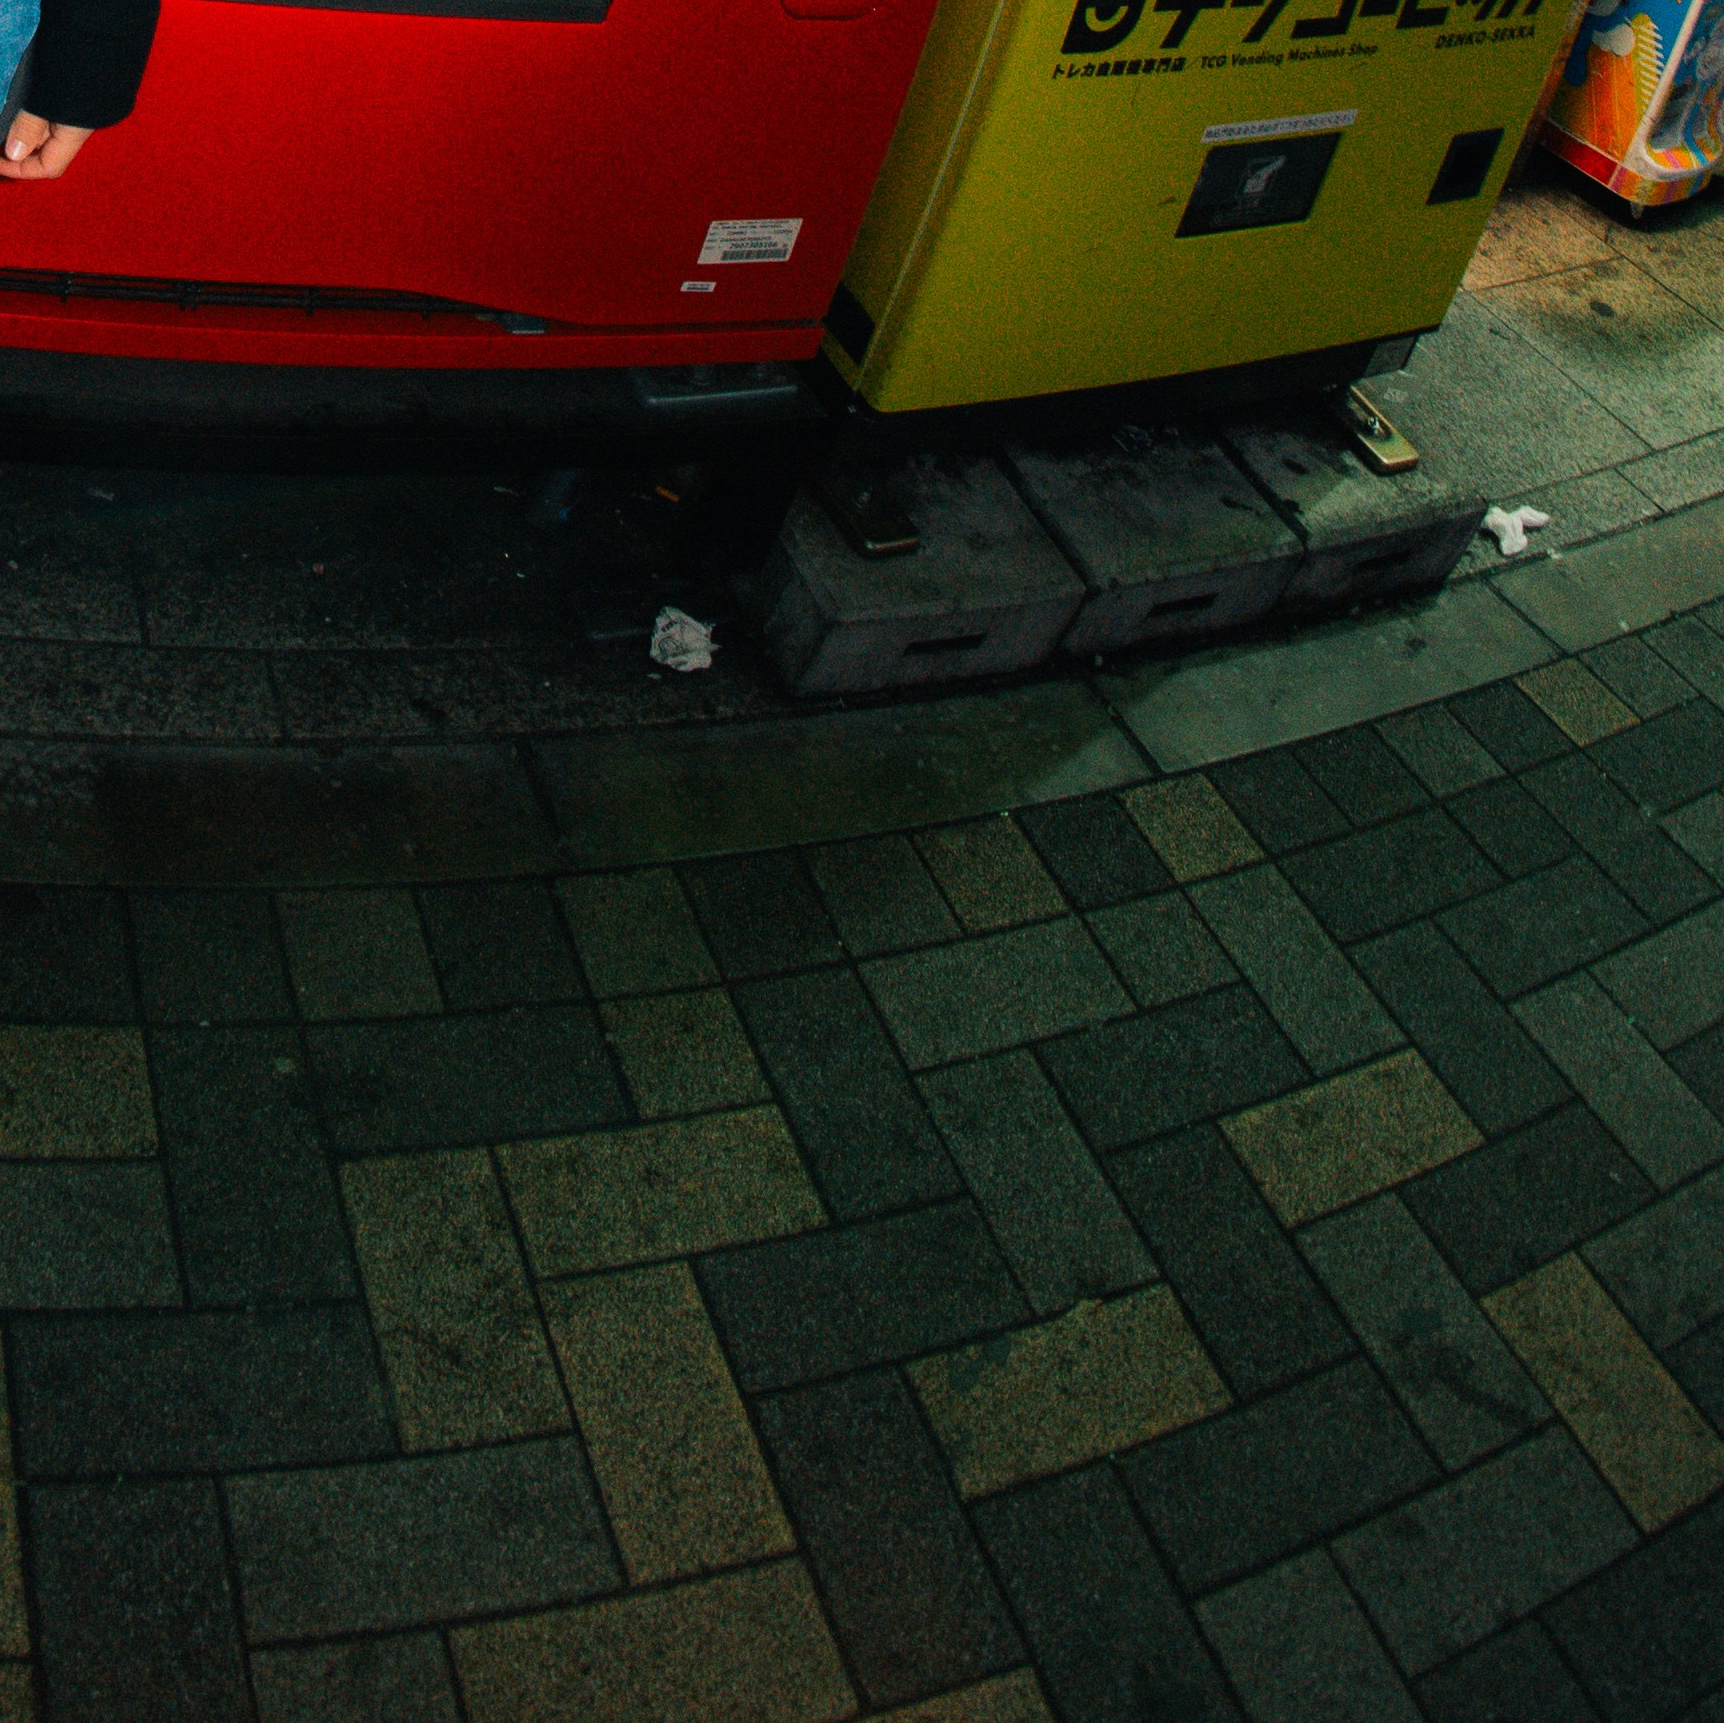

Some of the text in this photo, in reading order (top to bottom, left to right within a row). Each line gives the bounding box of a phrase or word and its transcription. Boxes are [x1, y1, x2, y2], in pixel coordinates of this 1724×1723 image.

[1435, 23, 1537, 49] DENKO-SEKKA
[1051, 55, 1187, 80] トレカ自販機専門店
[1199, 41, 1378, 70] TCG Vending Machines Shop
